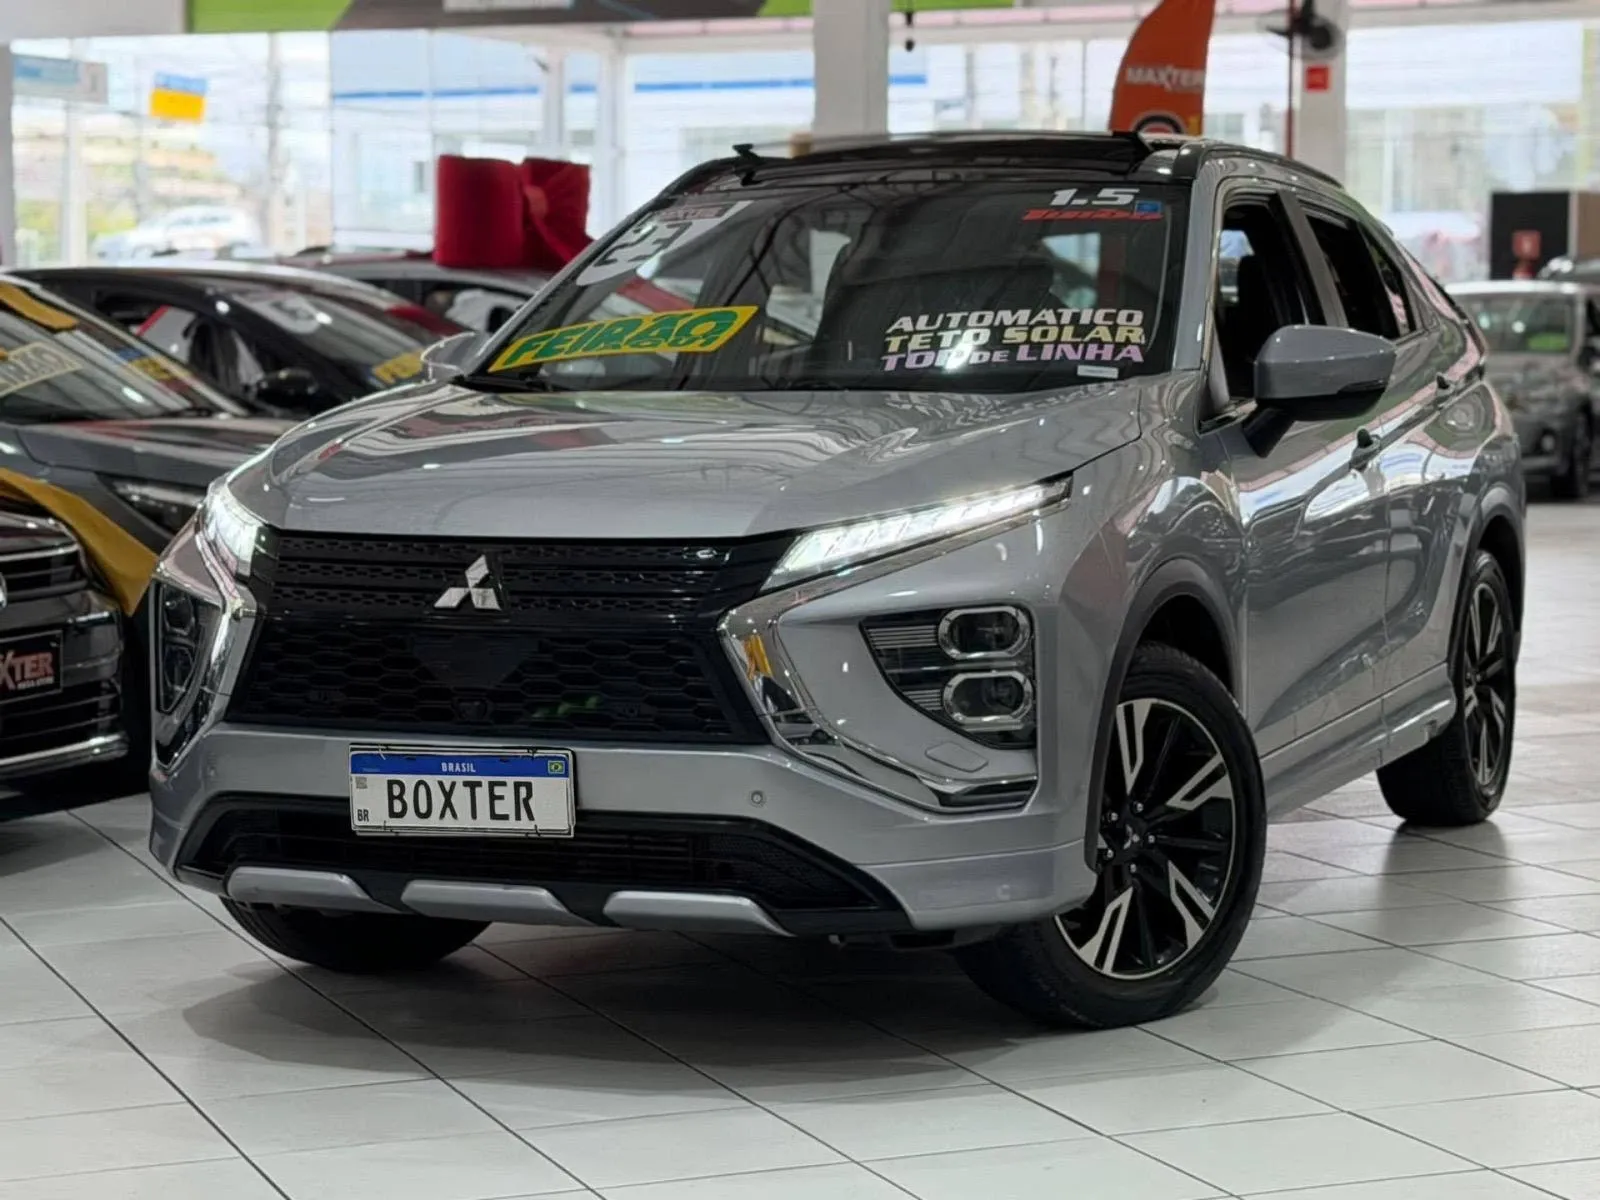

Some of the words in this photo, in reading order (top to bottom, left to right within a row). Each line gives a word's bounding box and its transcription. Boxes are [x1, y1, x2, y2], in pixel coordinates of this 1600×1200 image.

[1051, 188, 1140, 205] 1.5
[884, 327, 991, 352] TETO
[1002, 326, 1143, 344] SOLAR
[1016, 344, 1145, 362] LINHA
[441, 762, 476, 773] BRASIL
[386, 779, 535, 821] BOXTER
[357, 809, 369, 822] BR
